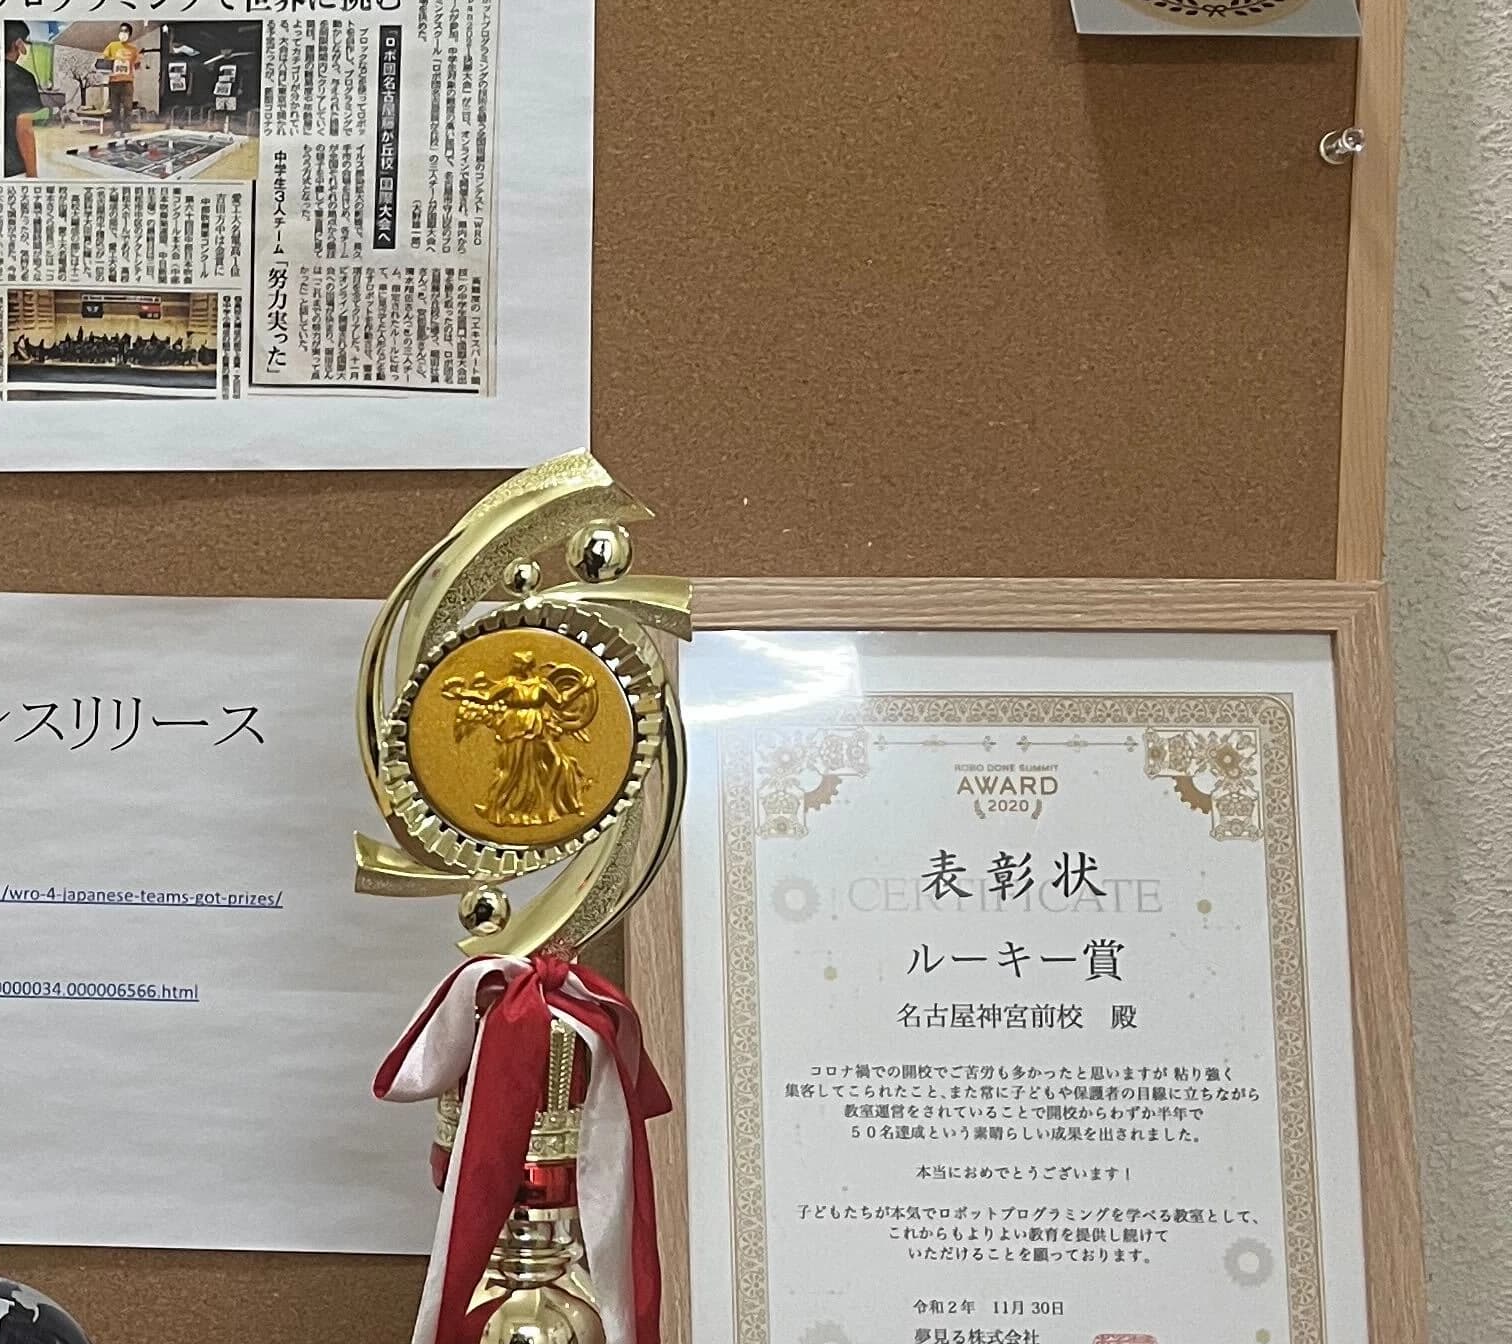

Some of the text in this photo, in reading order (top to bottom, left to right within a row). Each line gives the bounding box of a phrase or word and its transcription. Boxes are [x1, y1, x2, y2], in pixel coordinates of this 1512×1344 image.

[956, 775, 1059, 795] AWARD
[988, 799, 1029, 812] 2020
[920, 849, 1108, 902] 表彰状
[906, 939, 1125, 982] ルーキー賞
[896, 1003, 1138, 1031] 名古屋神宮前校 殿
[916, 1164, 1131, 1182] 本当におめでとうございます！
[993, 1300, 1025, 1316] 11月
[1031, 1301, 1065, 1316] 30日
